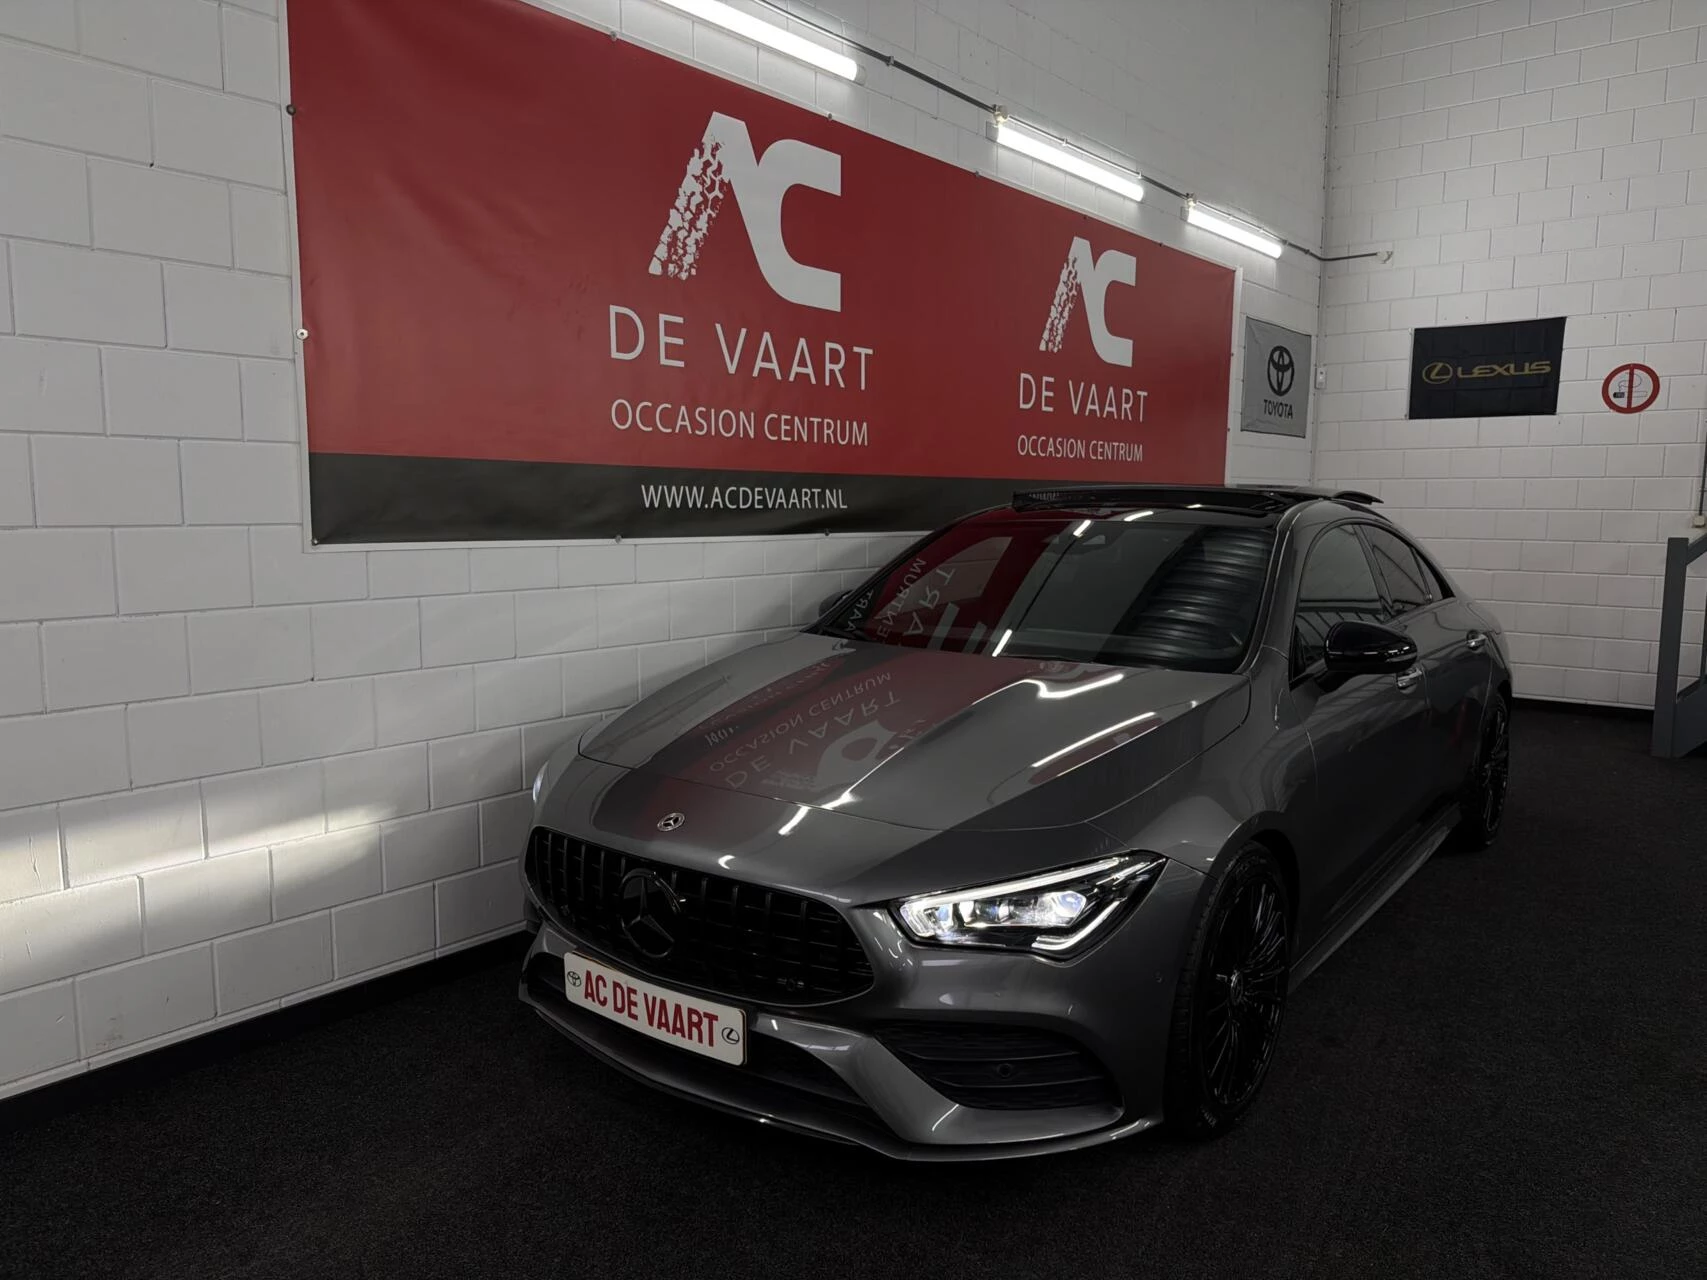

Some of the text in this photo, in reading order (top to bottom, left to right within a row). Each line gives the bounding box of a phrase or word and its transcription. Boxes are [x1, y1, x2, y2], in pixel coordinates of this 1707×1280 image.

[648, 111, 842, 313] AC
[1039, 236, 1137, 368] AC
[609, 304, 874, 390] DE VAART
[1457, 361, 1551, 379] LEXUS
[1019, 373, 1148, 423] DE VAART
[1263, 399, 1294, 419] TOYOTA
[611, 399, 868, 446] OCCASION CENTRUM
[1017, 435, 1143, 462] OCCASION CENTRUM
[641, 484, 848, 509] WWW.ACDEVAART.NL
[584, 970, 718, 1047] AC DE VAART
